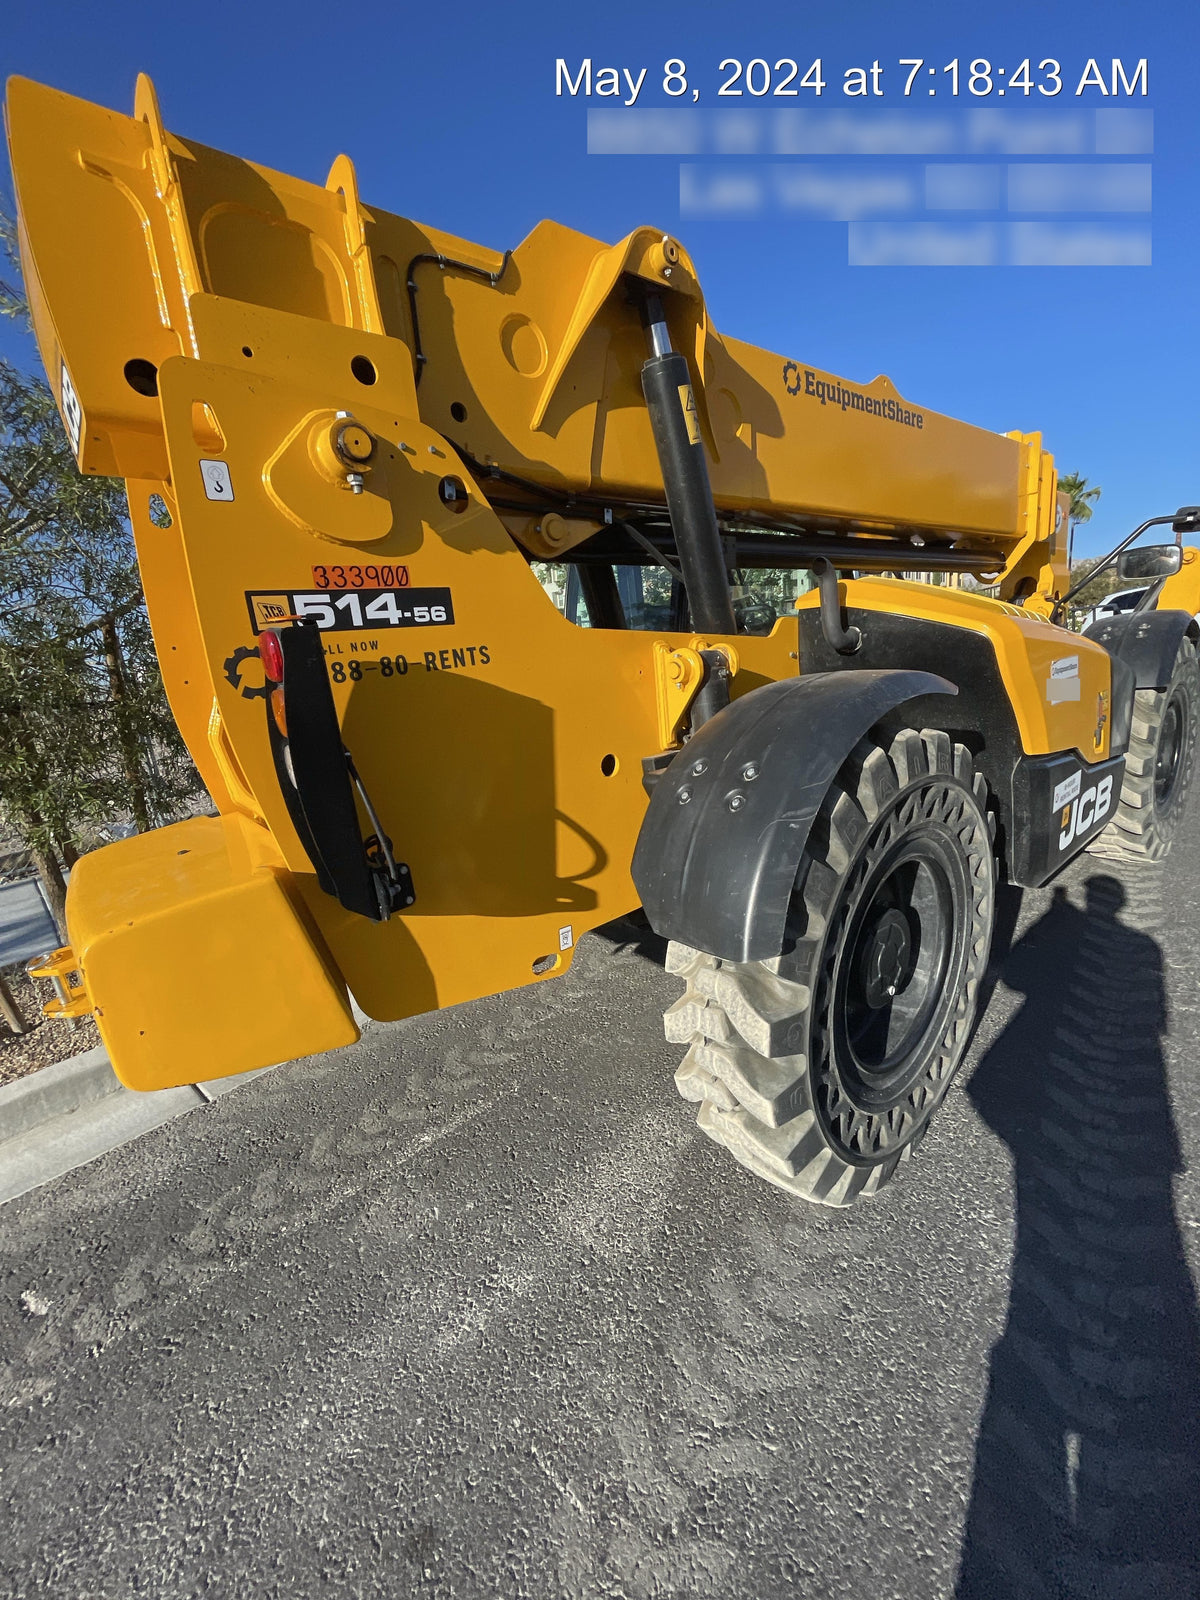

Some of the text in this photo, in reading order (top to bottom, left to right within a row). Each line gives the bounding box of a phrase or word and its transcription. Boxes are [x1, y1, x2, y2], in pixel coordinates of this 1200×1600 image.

[804, 370, 924, 429] EquipmentShare
[313, 565, 410, 589] 333900
[262, 605, 285, 619] JCB
[292, 592, 447, 630] 514-56
[350, 640, 379, 653] NOW
[1059, 774, 1114, 851] JCB
